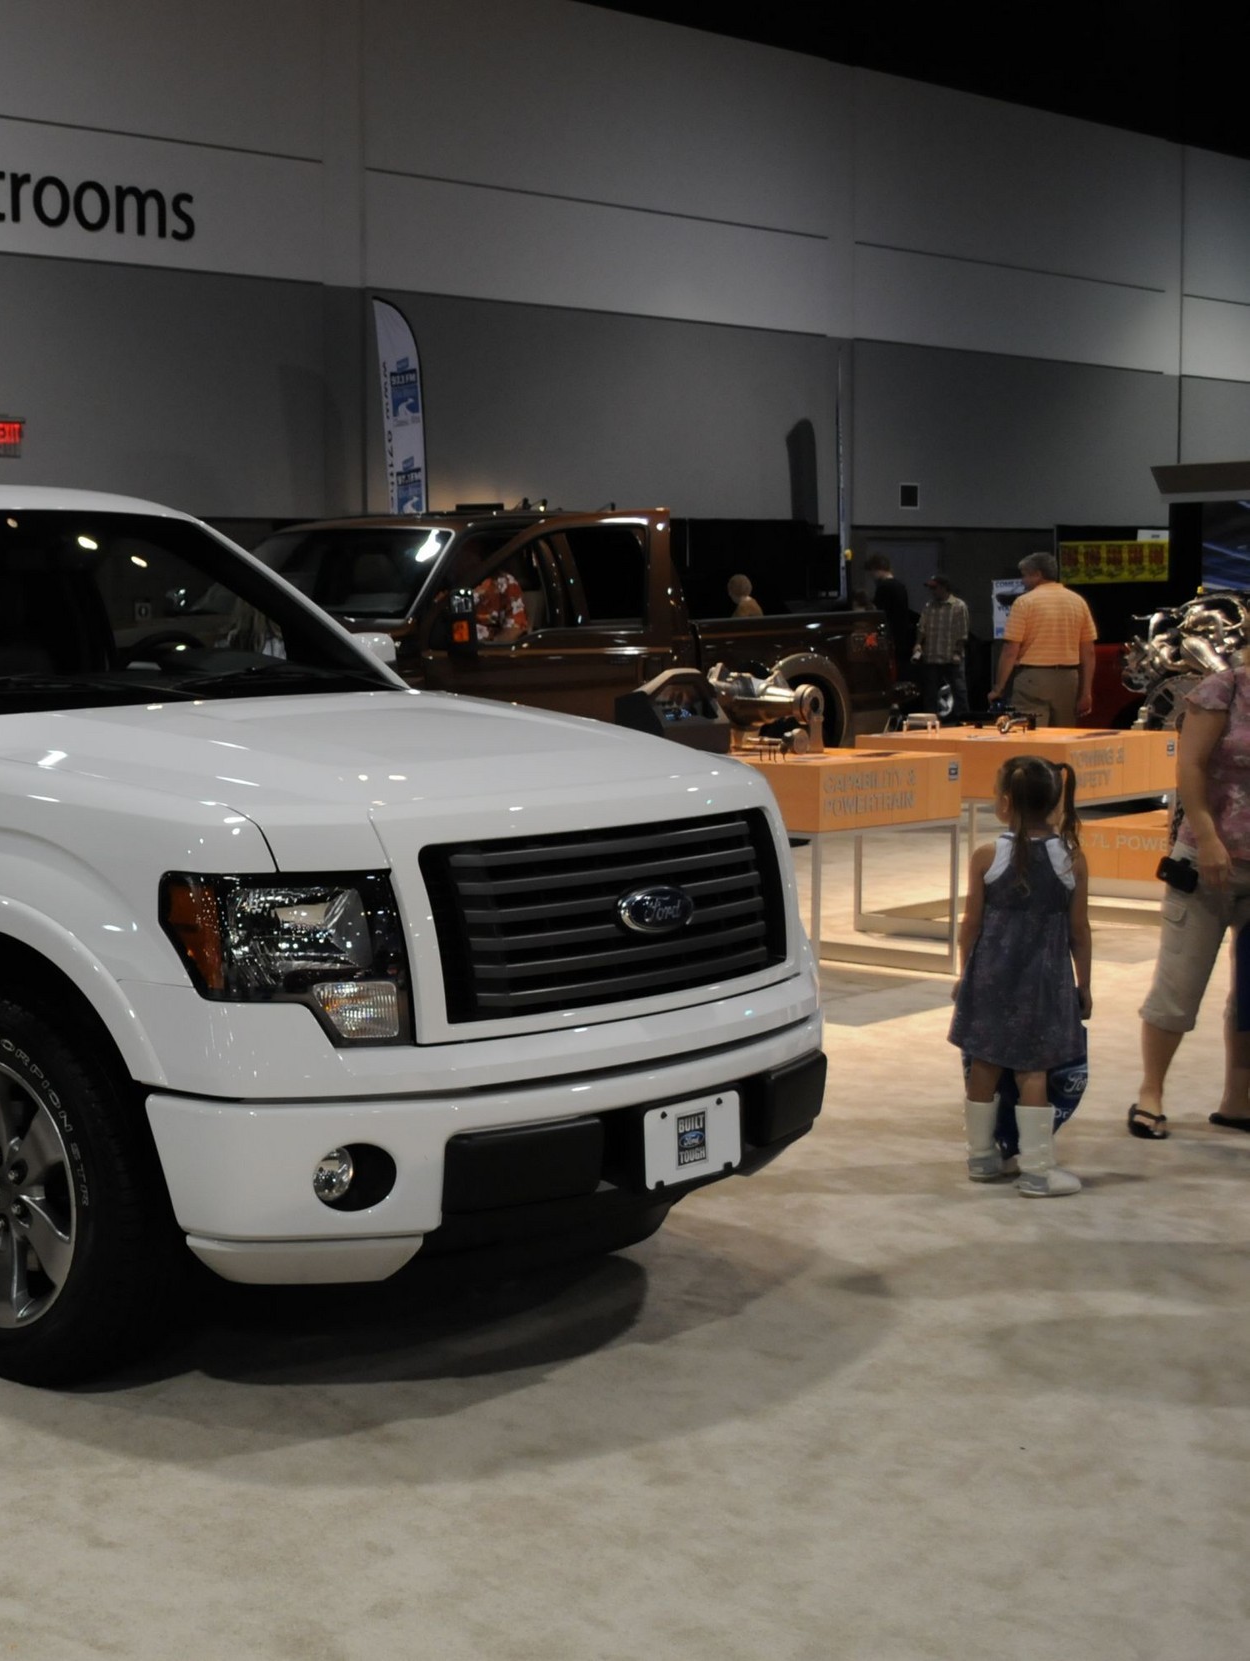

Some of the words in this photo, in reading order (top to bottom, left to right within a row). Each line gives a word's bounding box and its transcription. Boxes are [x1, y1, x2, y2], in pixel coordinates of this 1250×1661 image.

[823, 768, 901, 794] CAPABILITY
[1076, 769, 1111, 788] AFETY
[823, 790, 915, 817] POWERTRAIN
[1116, 834, 1168, 852] POWE
[643, 895, 682, 923] Ford
[1063, 1070, 1088, 1093] Fo
[678, 1114, 705, 1133] BUILT
[683, 1134, 701, 1147] Ford
[679, 1146, 706, 1164] TOUGH
